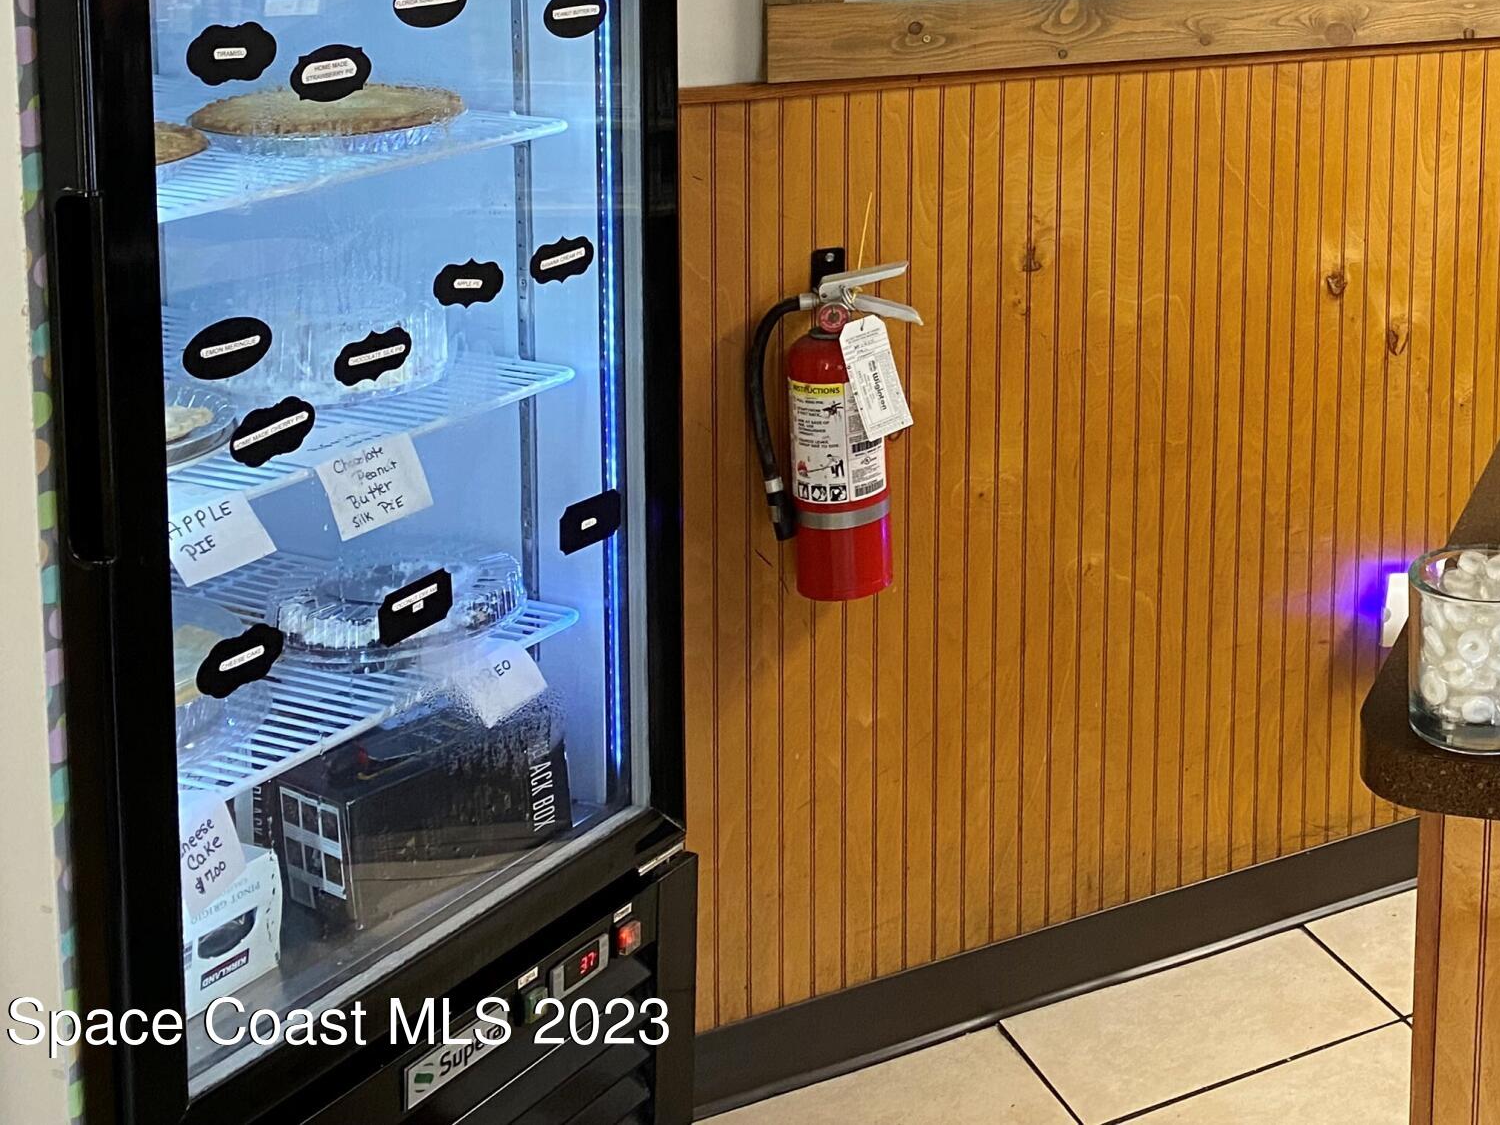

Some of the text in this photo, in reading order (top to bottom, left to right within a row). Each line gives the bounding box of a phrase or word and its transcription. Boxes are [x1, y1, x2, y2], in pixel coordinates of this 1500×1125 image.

[215, 48, 246, 58] TIRAMISU
[313, 60, 349, 71] HOME MADE
[252, 429, 270, 443] MADE
[269, 419, 295, 437] CHERRY
[346, 481, 394, 511] Butter
[167, 500, 233, 542] APPLE
[180, 533, 217, 562] PIE
[532, 794, 556, 833] BOX
[187, 835, 223, 872] Cake
[201, 955, 249, 989] KIRKLAND
[579, 950, 598, 976] 37
